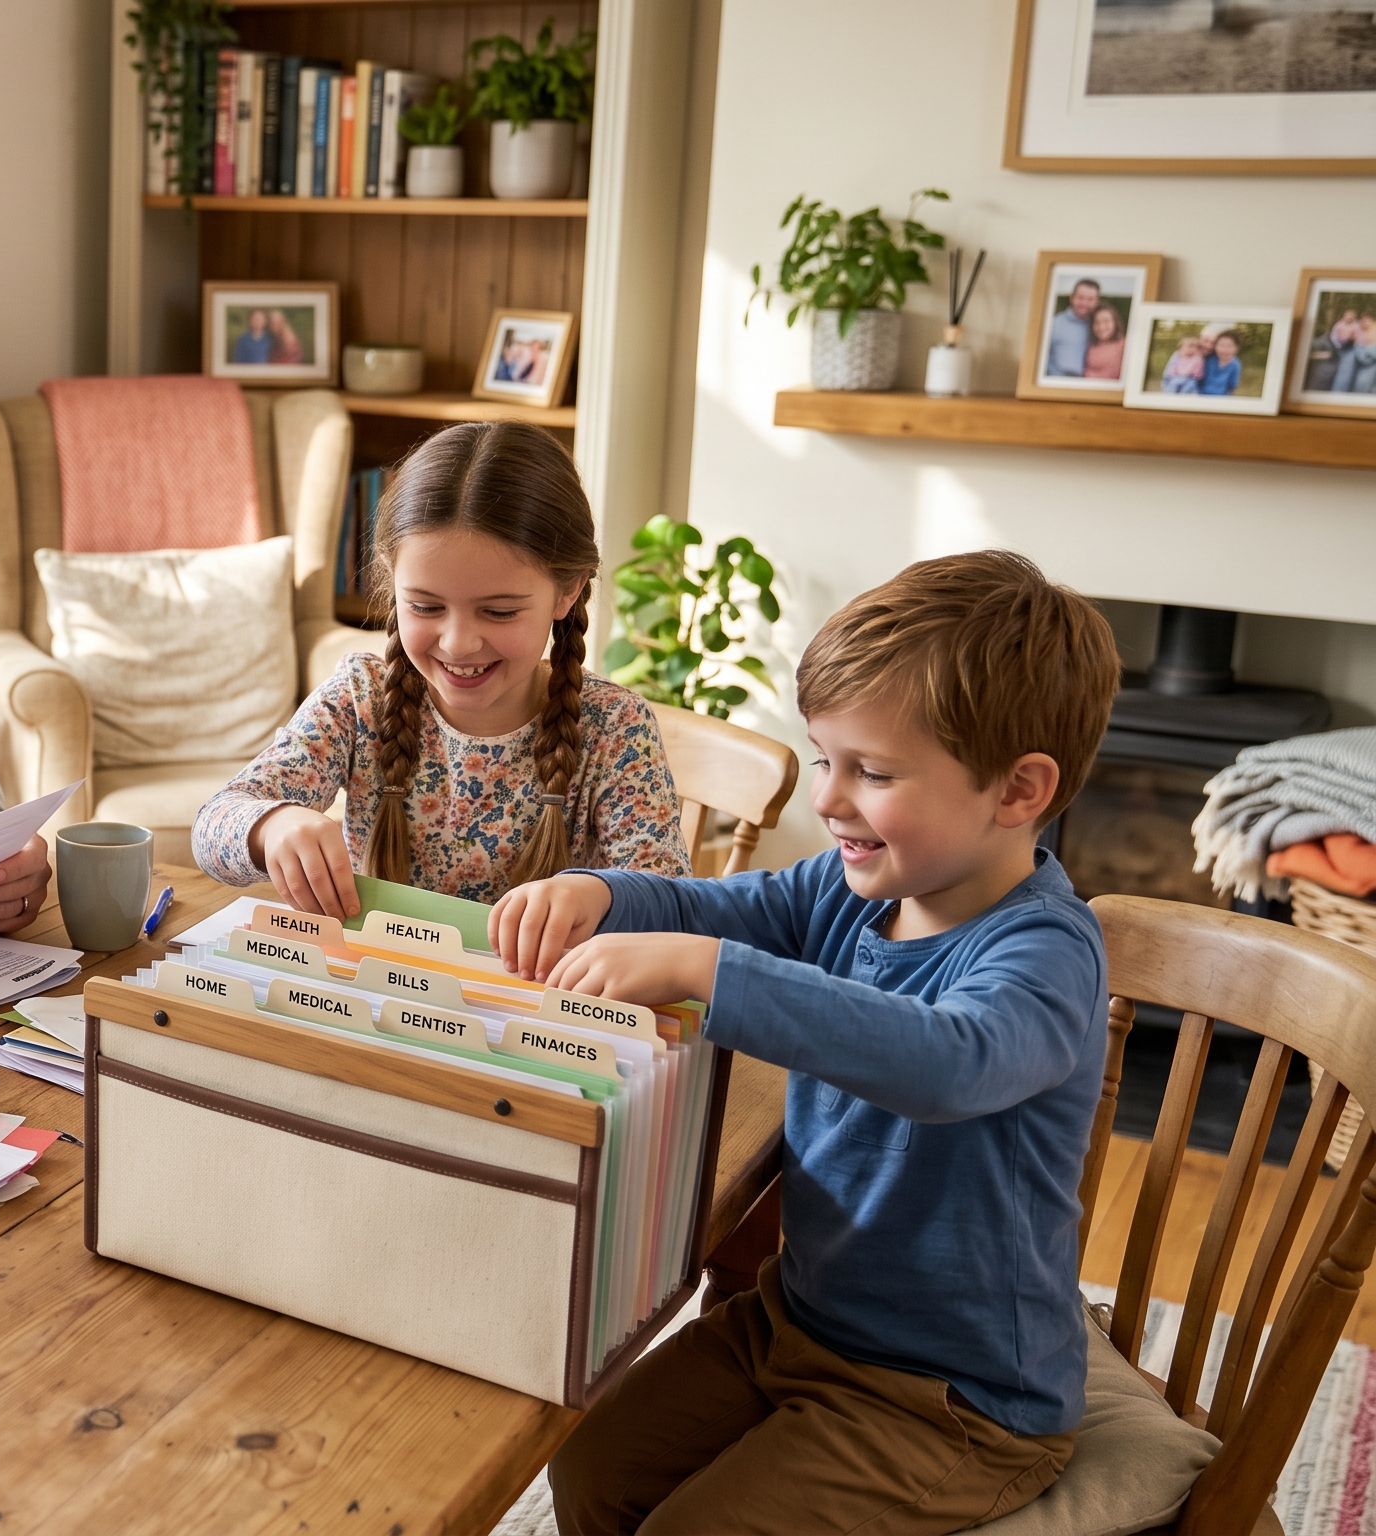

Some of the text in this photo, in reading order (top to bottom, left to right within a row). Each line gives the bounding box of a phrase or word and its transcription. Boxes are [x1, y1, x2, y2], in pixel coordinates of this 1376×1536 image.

[271, 914, 319, 935] HEALTH
[386, 922, 440, 943] HEALTH
[246, 940, 309, 965] MEDICAL
[186, 974, 227, 996] HOME
[388, 972, 429, 992] BILLS
[288, 990, 352, 1017] MEDICAL
[561, 1000, 637, 1027] BECORDS
[401, 1011, 467, 1037] DENTIST
